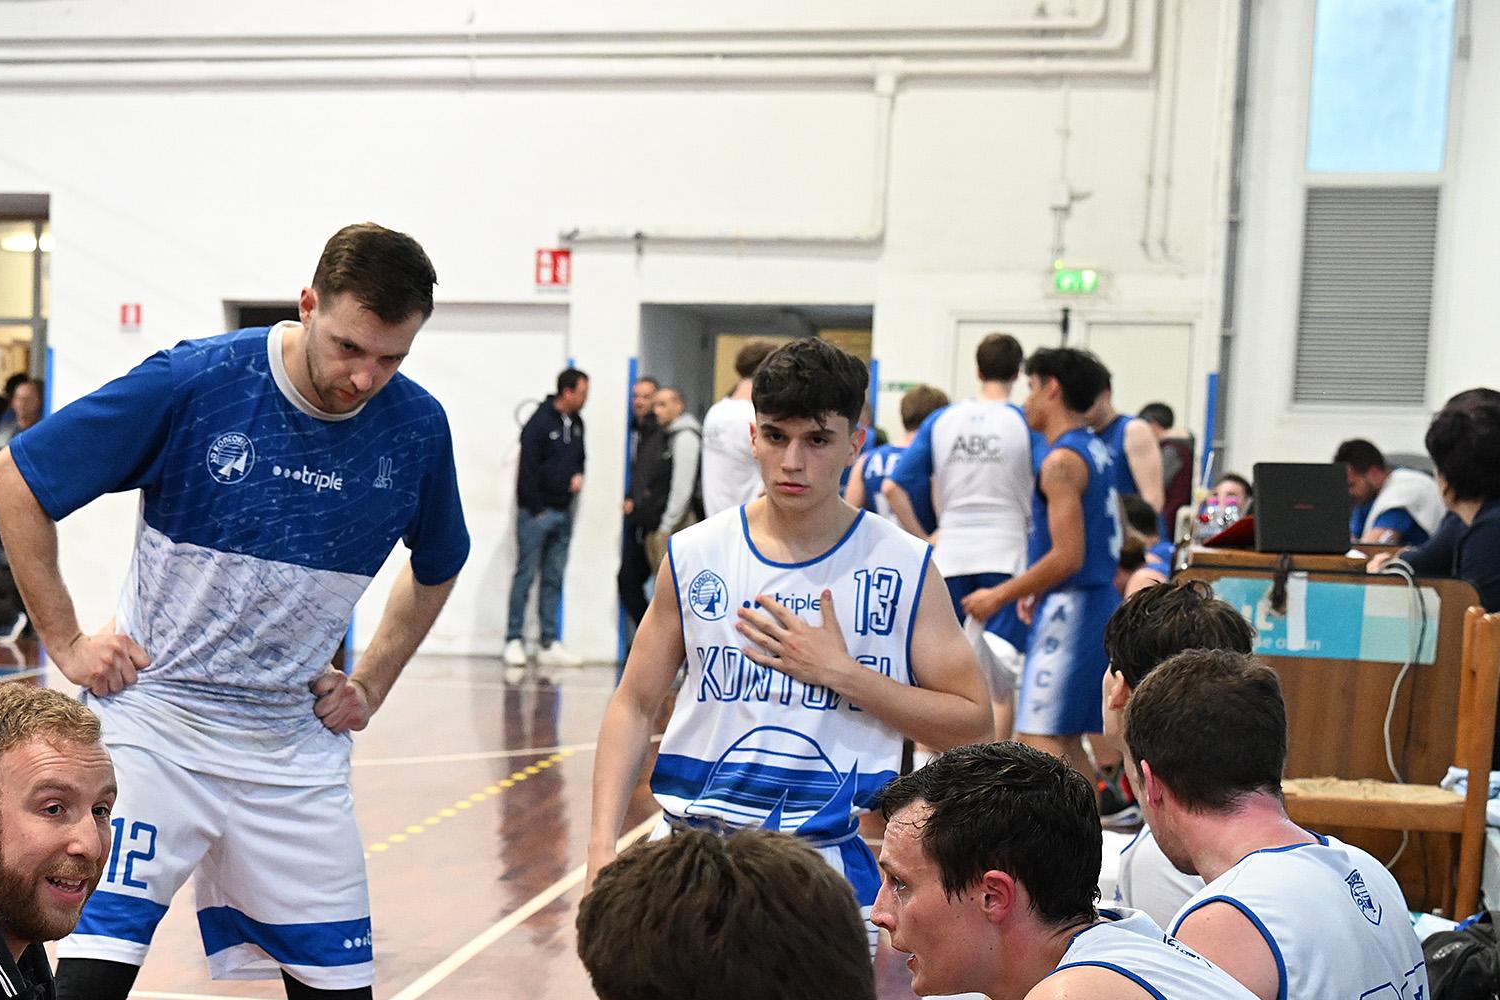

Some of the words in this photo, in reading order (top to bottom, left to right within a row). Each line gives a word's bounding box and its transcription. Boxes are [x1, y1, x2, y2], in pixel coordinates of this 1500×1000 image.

[950, 433, 1002, 456] ABC
[301, 465, 343, 492] triple
[775, 592, 821, 616] triple
[854, 567, 902, 636] 13
[106, 817, 157, 890] 12
